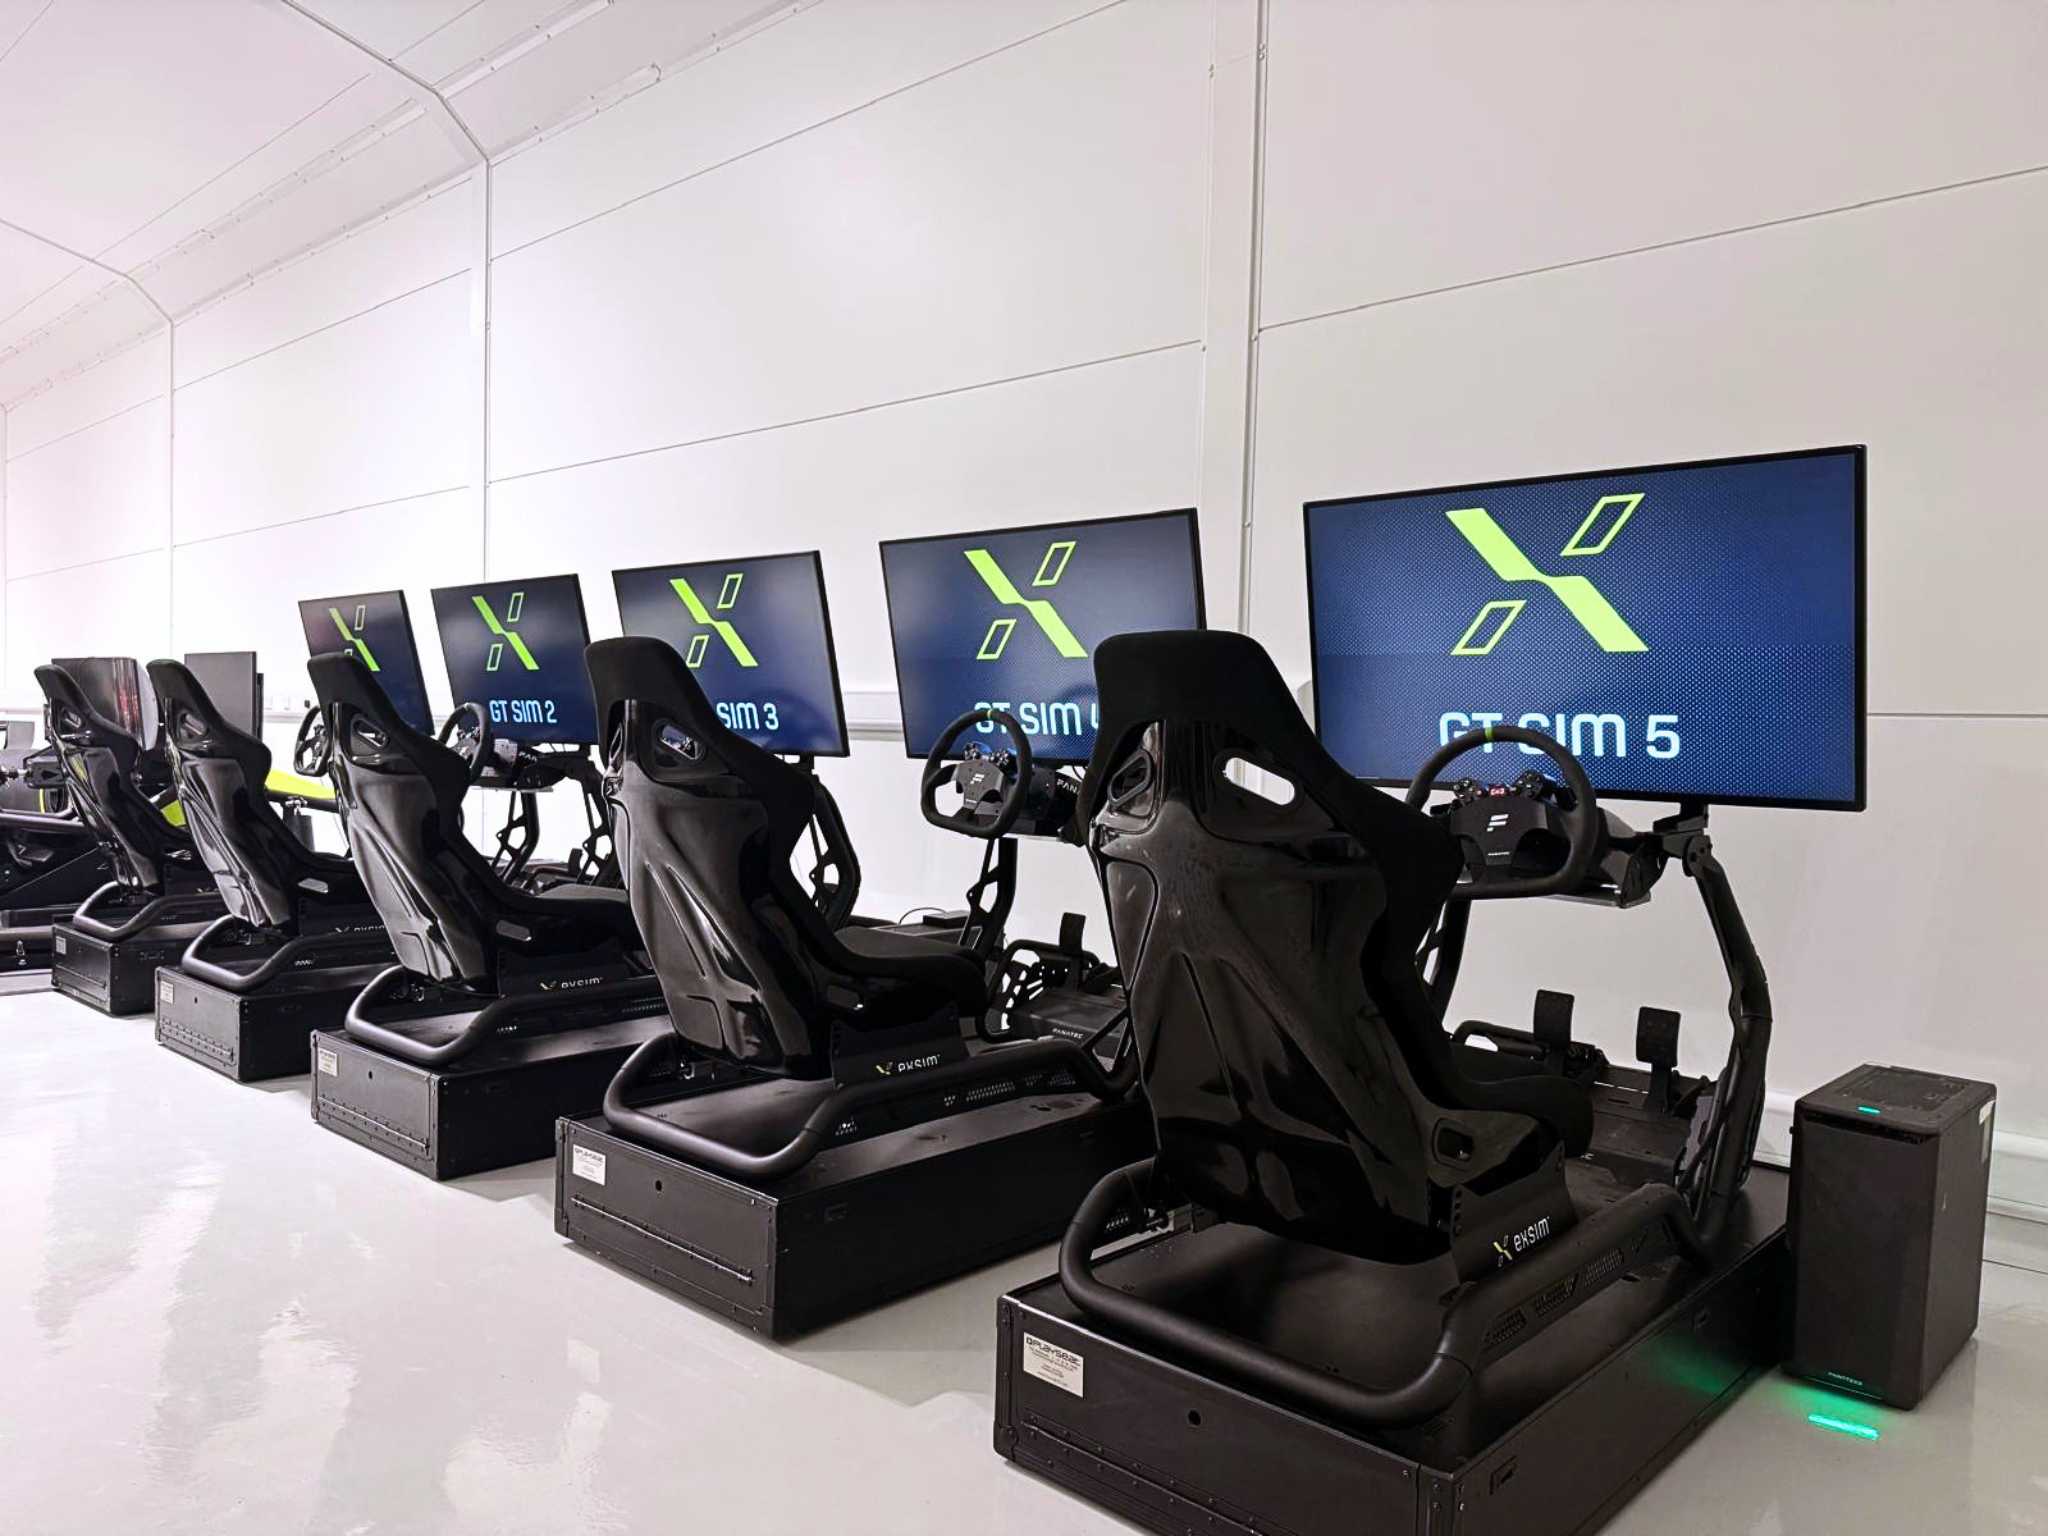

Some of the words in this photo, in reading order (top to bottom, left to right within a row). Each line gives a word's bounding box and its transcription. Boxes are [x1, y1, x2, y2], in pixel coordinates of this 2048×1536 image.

[489, 700, 508, 723] GT
[544, 700, 558, 723] 2
[763, 702, 779, 730] 3
[1646, 714, 1681, 759] 5
